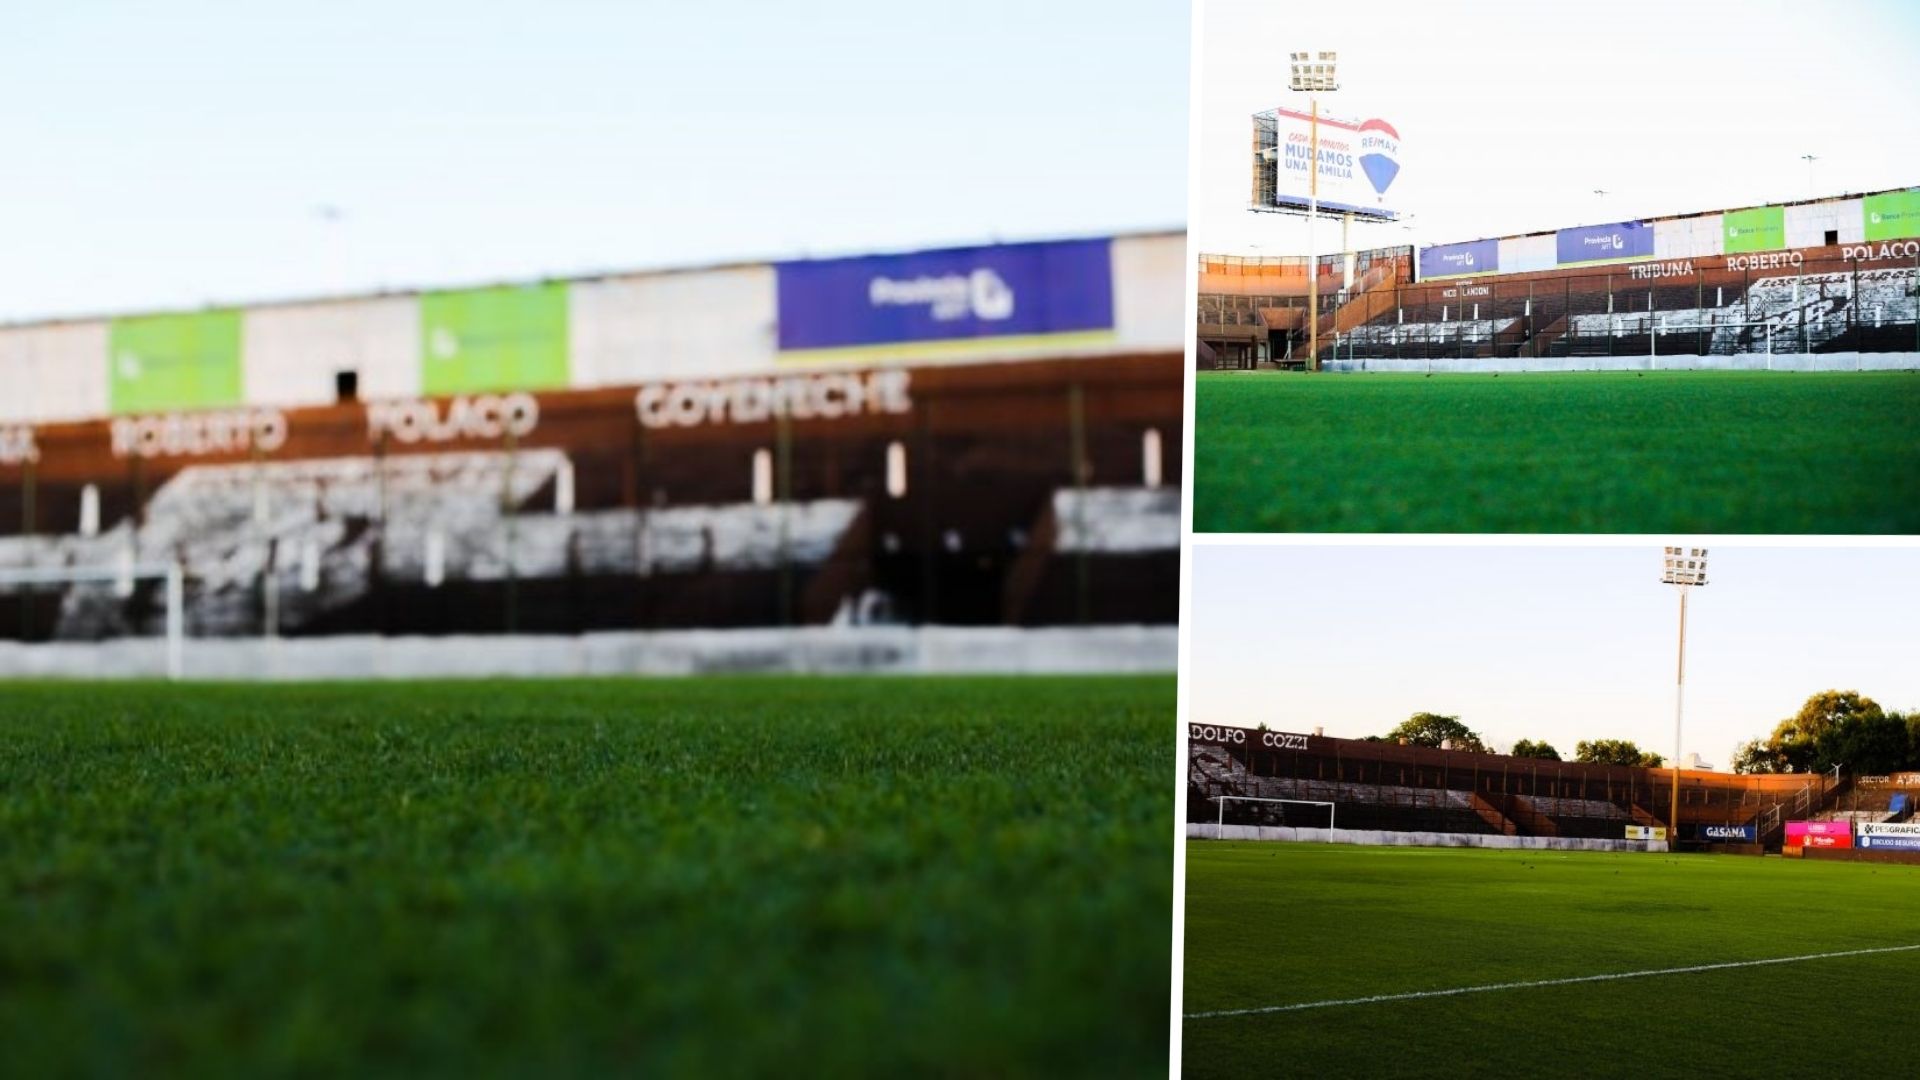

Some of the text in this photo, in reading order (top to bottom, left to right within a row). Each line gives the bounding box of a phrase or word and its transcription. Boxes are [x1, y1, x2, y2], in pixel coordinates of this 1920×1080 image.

[1285, 142, 1353, 168] MUDAMOS
[1285, 158, 1353, 179] UNA AMILIA
[1629, 241, 1920, 280] TRIBUNA ROBERTO POLACO
[1188, 725, 1309, 750] DOLFO COZZI
[1706, 826, 1746, 838] GASANA
